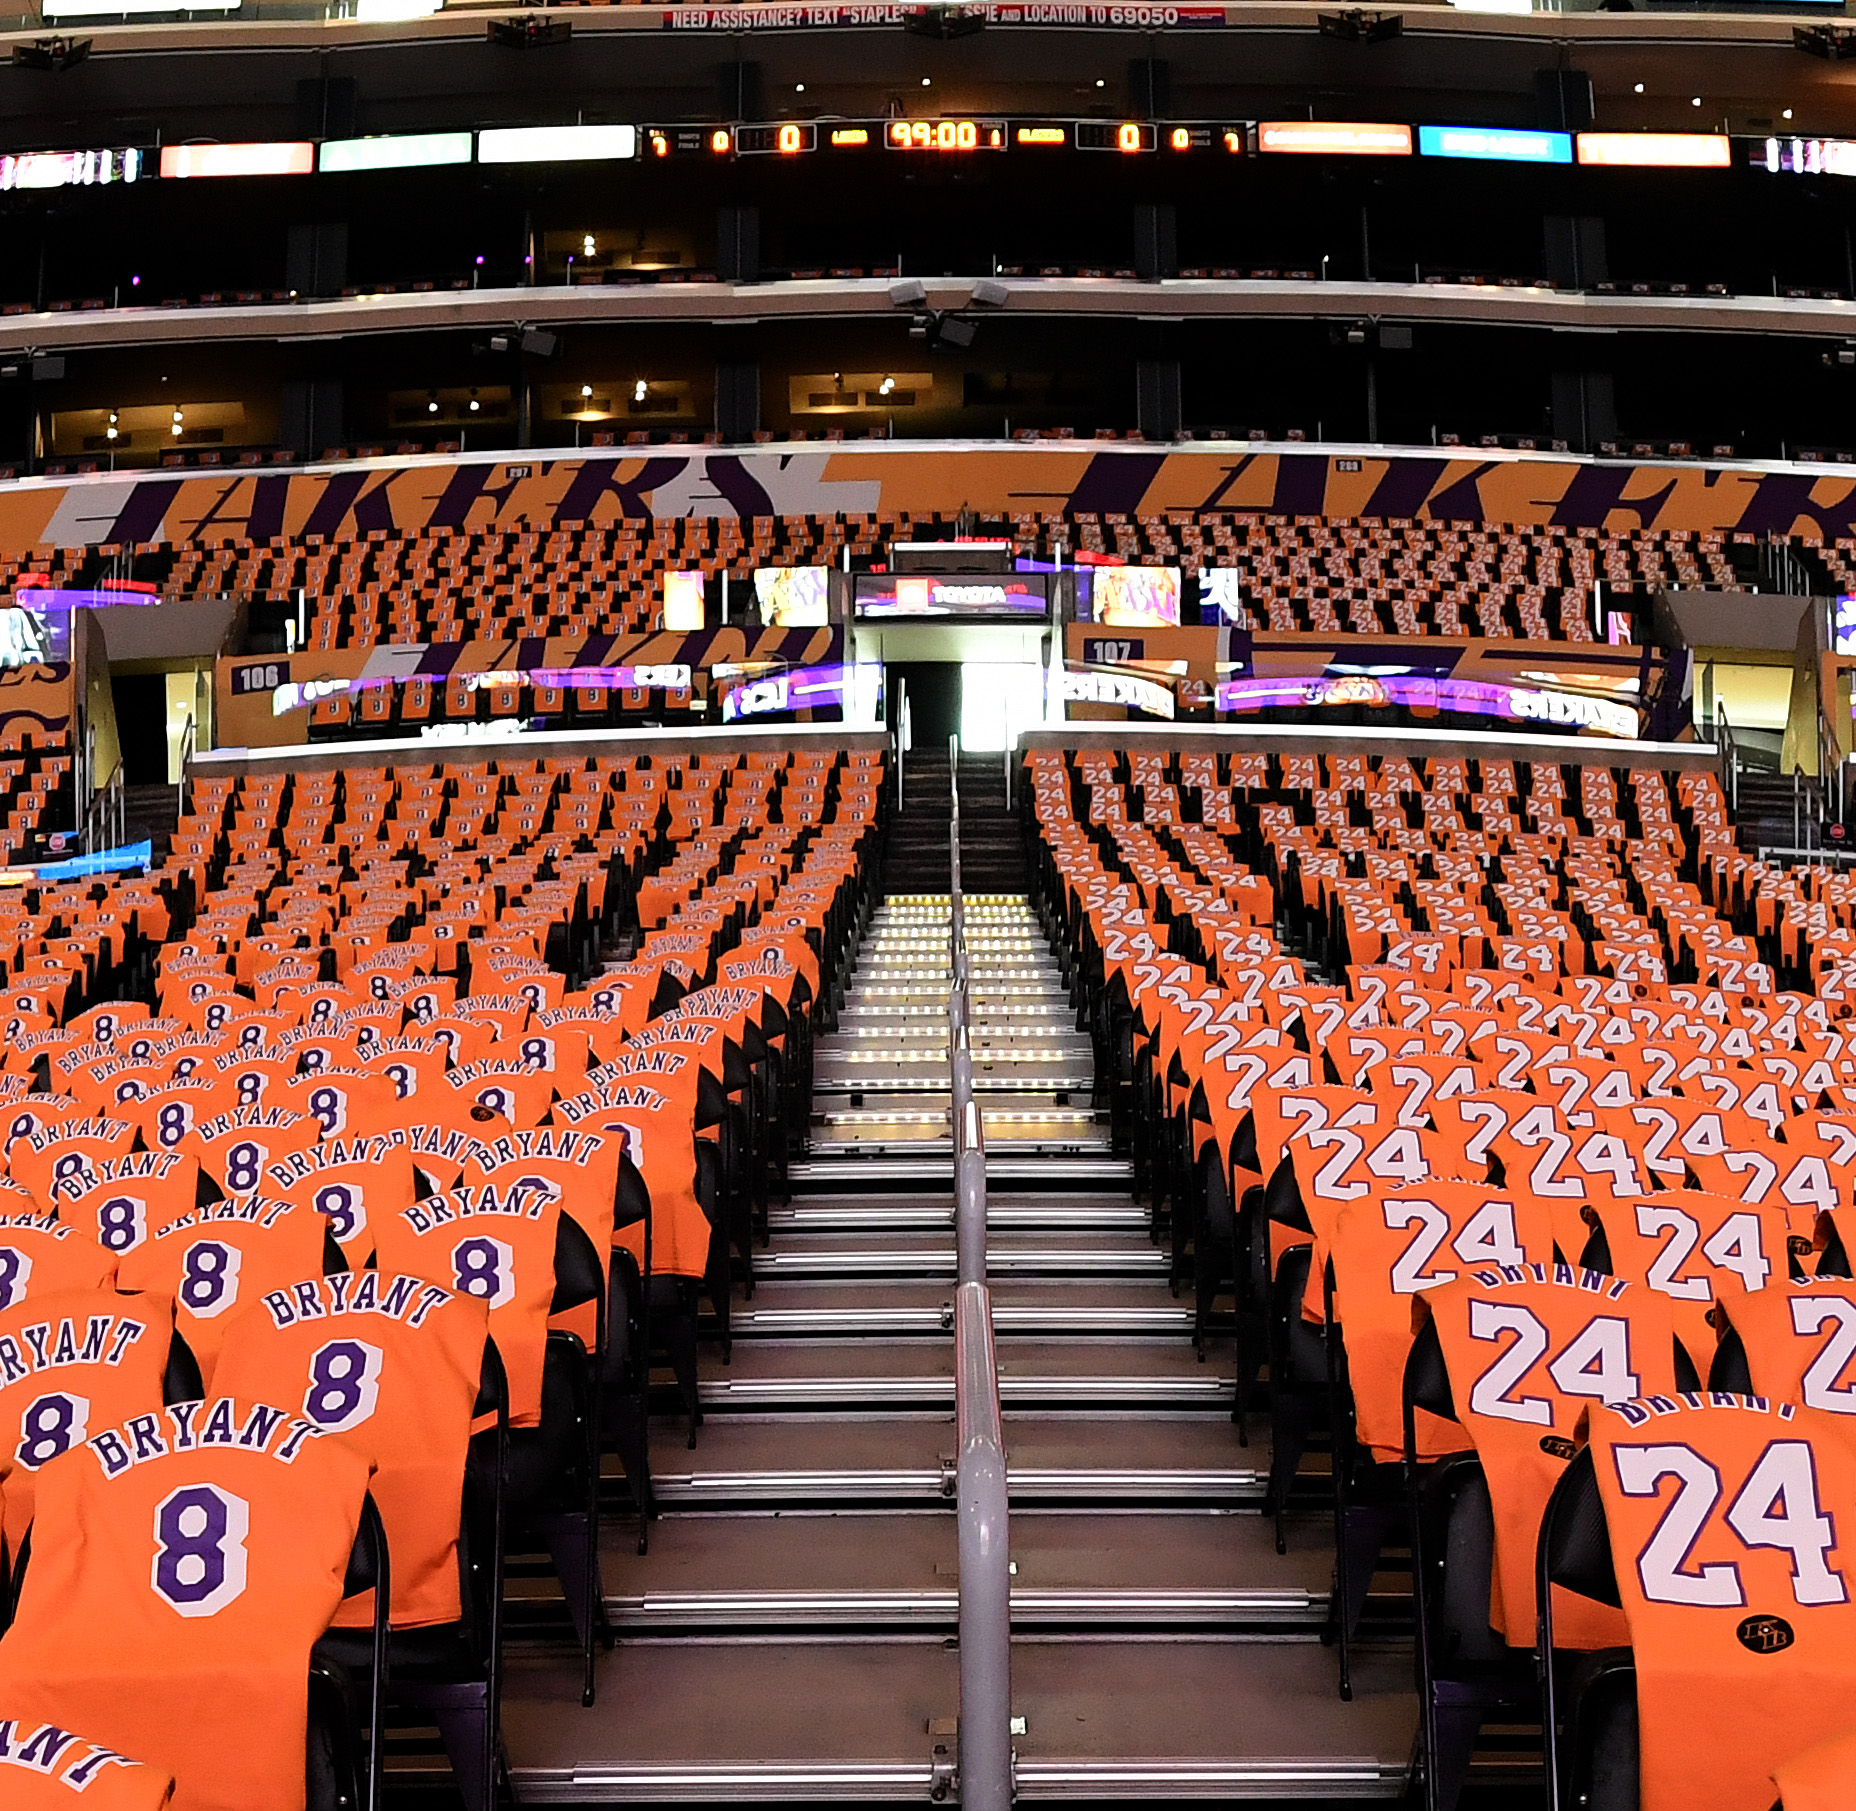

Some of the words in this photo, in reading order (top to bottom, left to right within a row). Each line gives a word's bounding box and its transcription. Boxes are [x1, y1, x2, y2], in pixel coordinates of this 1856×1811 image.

[672, 10, 706, 29] NEED
[711, 8, 803, 28] ASSISTANCE?
[806, 7, 838, 25] TEXT
[1024, 6, 1105, 24] LOCATION
[1109, 8, 1127, 23] TO
[1130, 8, 1178, 25] 69050
[779, 124, 800, 151] 0
[891, 121, 977, 148] 99:00
[1119, 123, 1140, 151] 0
[930, 583, 1006, 603] TOYOTA
[1094, 640, 1132, 664] 107
[241, 663, 278, 692] 106
[1693, 790, 1717, 807] 24
[1104, 929, 1156, 961] 24
[91, 1014, 118, 1042] 8
[1306, 1126, 1430, 1200] 24
[1382, 1198, 1525, 1296] 24
[1635, 1203, 1771, 1302] 24
[178, 1240, 242, 1319] 8
[451, 1236, 515, 1311] 8
[260, 1270, 453, 1328] BRYANT
[1467, 1298, 1639, 1428] 24
[303, 1338, 383, 1434] 8
[89, 1396, 328, 1480] BRYANT
[1611, 1439, 1849, 1606] 24
[150, 1482, 249, 1617] 8
